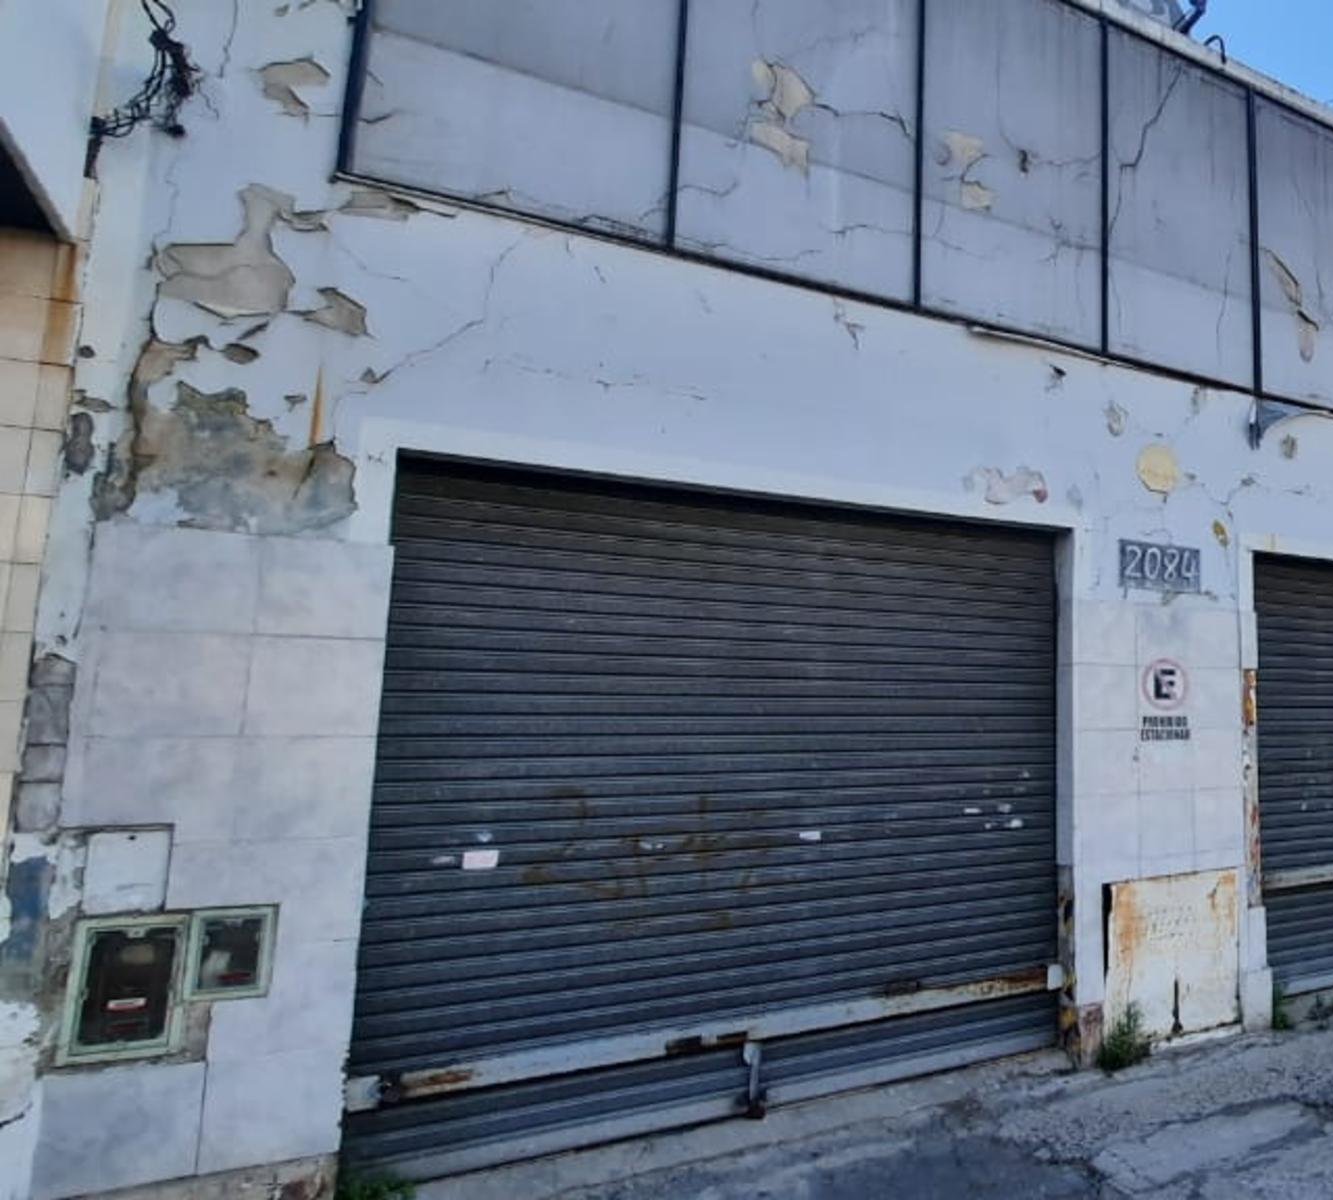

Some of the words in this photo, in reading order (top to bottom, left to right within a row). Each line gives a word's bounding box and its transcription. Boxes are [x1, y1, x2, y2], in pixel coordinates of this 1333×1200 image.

[1124, 544, 1200, 582] 2084
[1142, 715, 1188, 728] PROHIBIDO
[1140, 729, 1191, 741] ESTACIONAR
